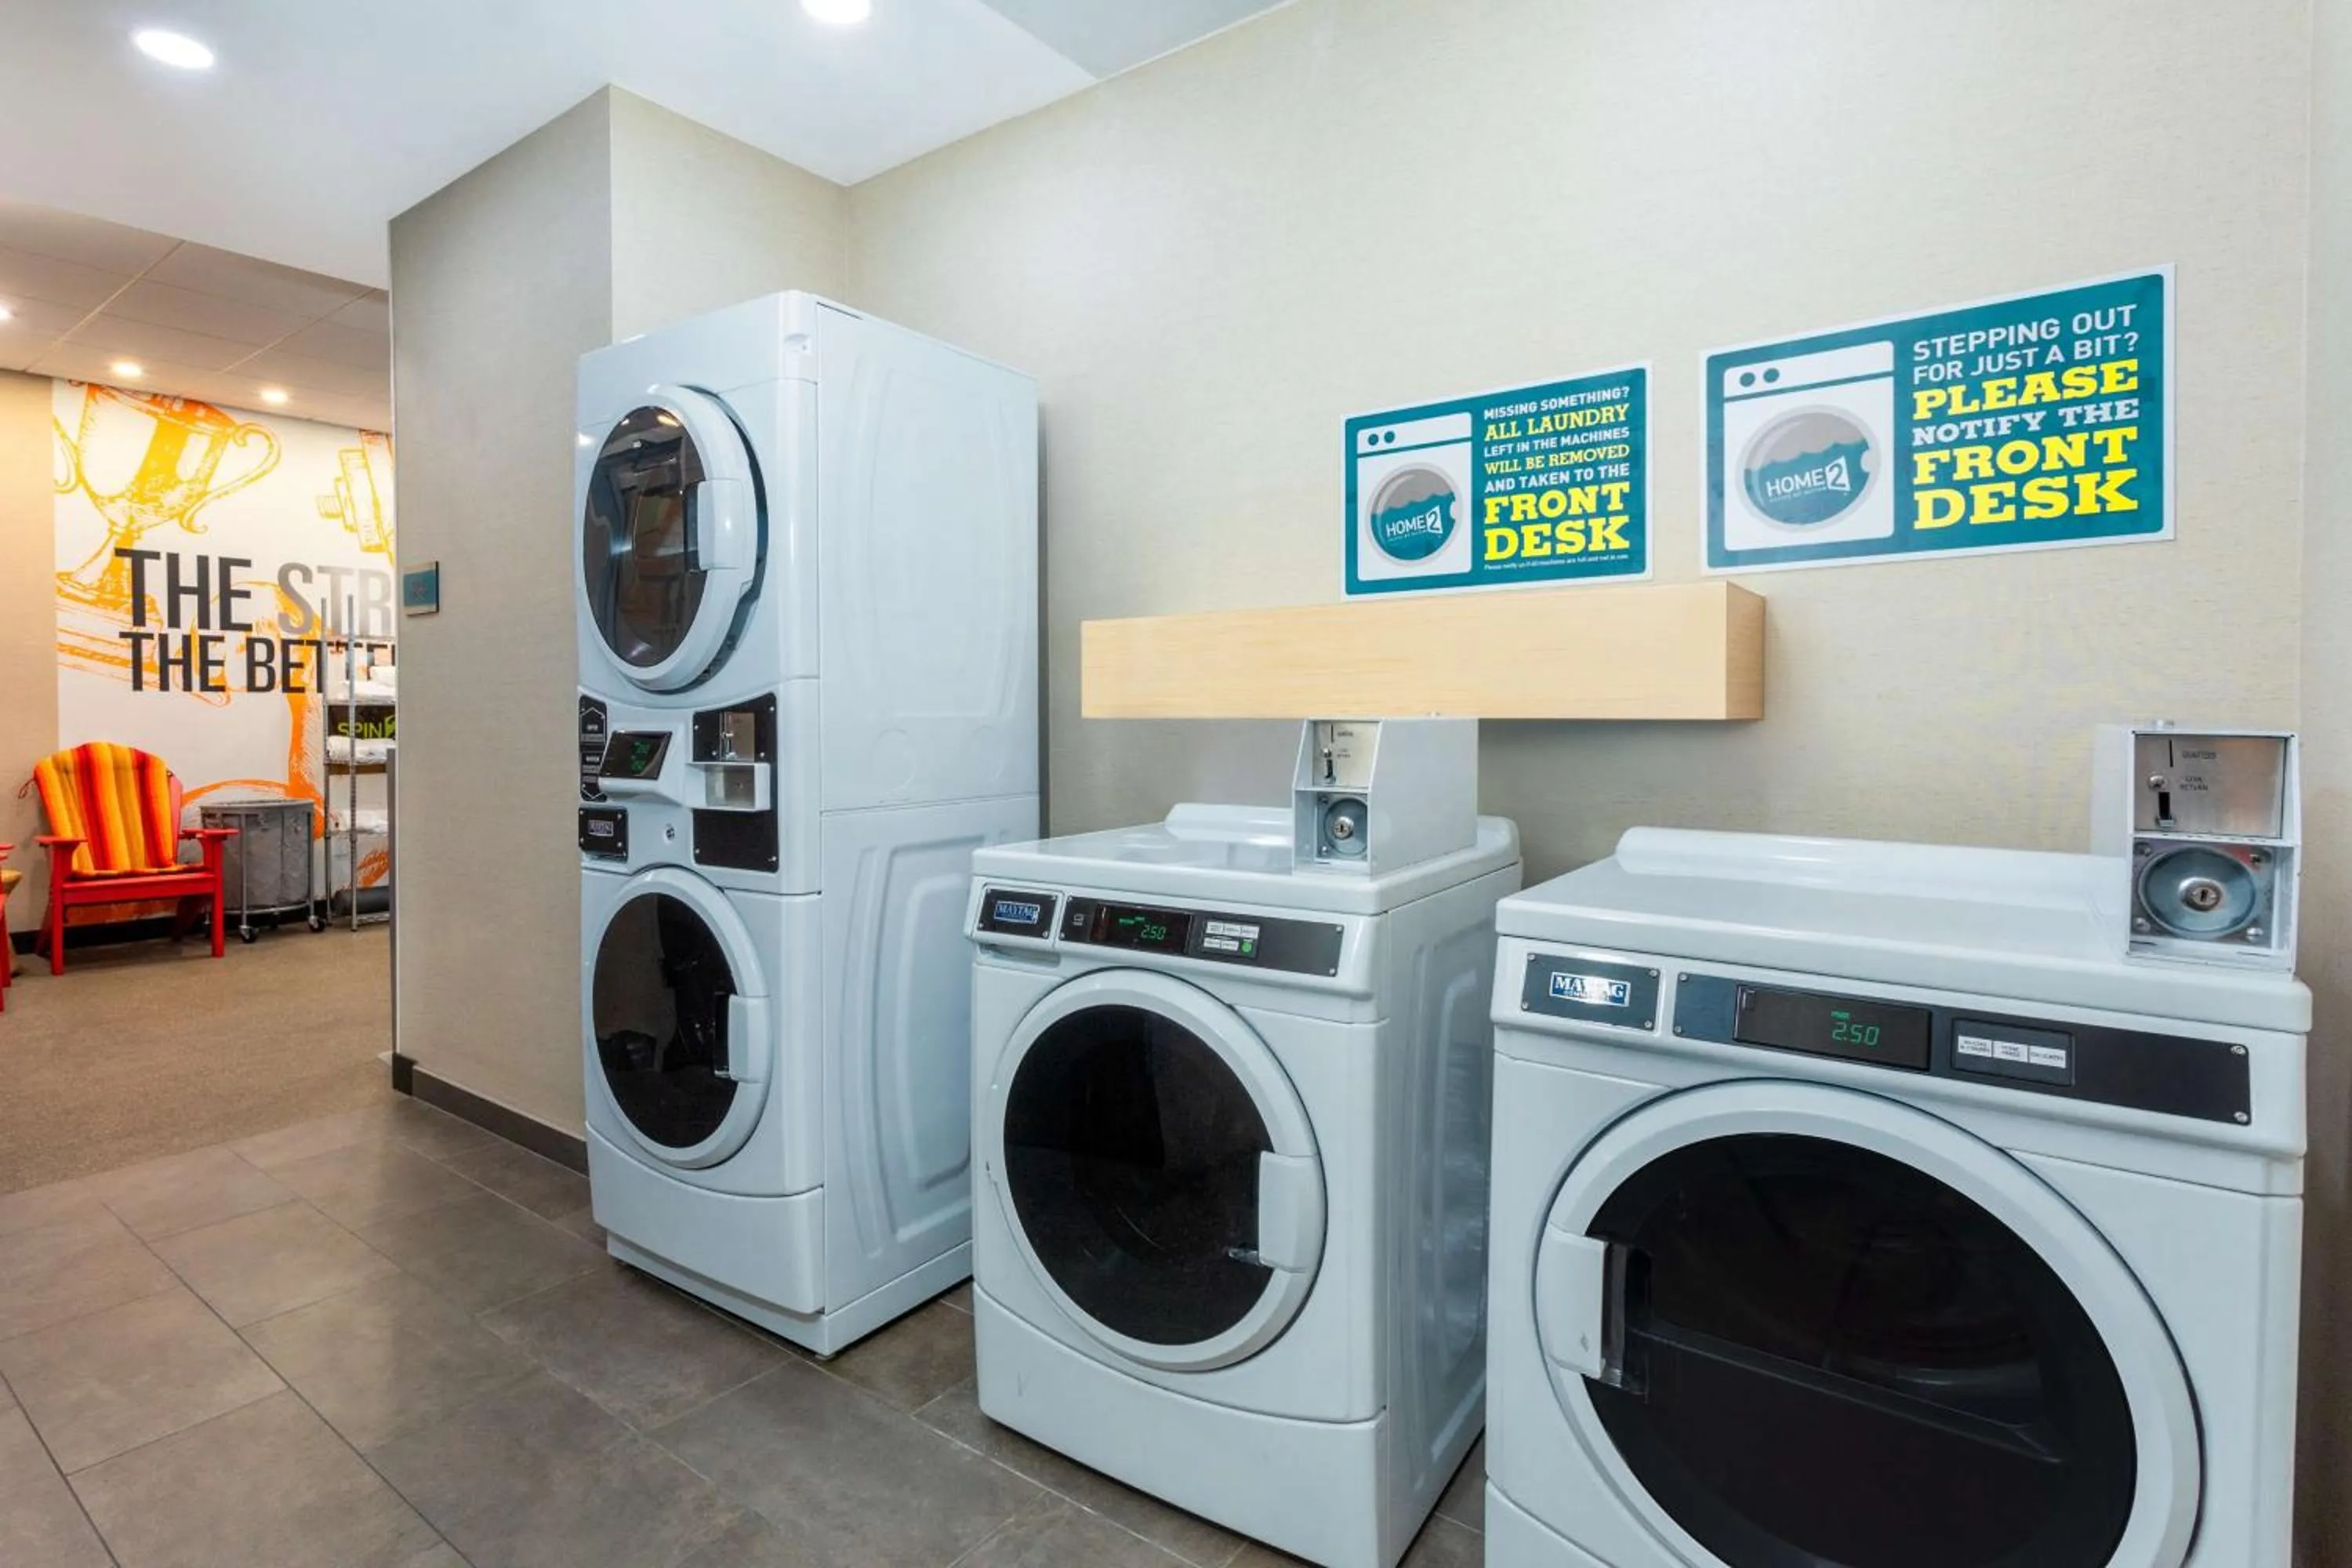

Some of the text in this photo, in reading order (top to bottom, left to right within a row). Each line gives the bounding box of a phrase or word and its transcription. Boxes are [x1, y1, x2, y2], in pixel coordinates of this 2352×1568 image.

[1912, 303, 2136, 361] STEPPING OUT
[1914, 332, 2140, 384] FOR JUST A BIT?
[1484, 387, 1630, 420] MISSING SOMETHING?
[1912, 358, 2139, 419] PLEASE
[1484, 404, 1630, 441] ALL LAUNDRY
[1484, 427, 1630, 458] LEFT IN THE MACHINES
[1912, 398, 2140, 446] NOTIFY THE
[1484, 445, 1630, 475] WILL BE REMOVED
[1485, 463, 1630, 493] AND TAKEN TO THE
[1914, 426, 2138, 485] FRONT
[1484, 481, 1630, 524] FRONT
[1914, 470, 2138, 529] DESK
[1484, 515, 1630, 561] DESK
[114, 547, 252, 631] THE
[119, 631, 396, 694] THE BETT
[1555, 975, 1624, 998] MAG
